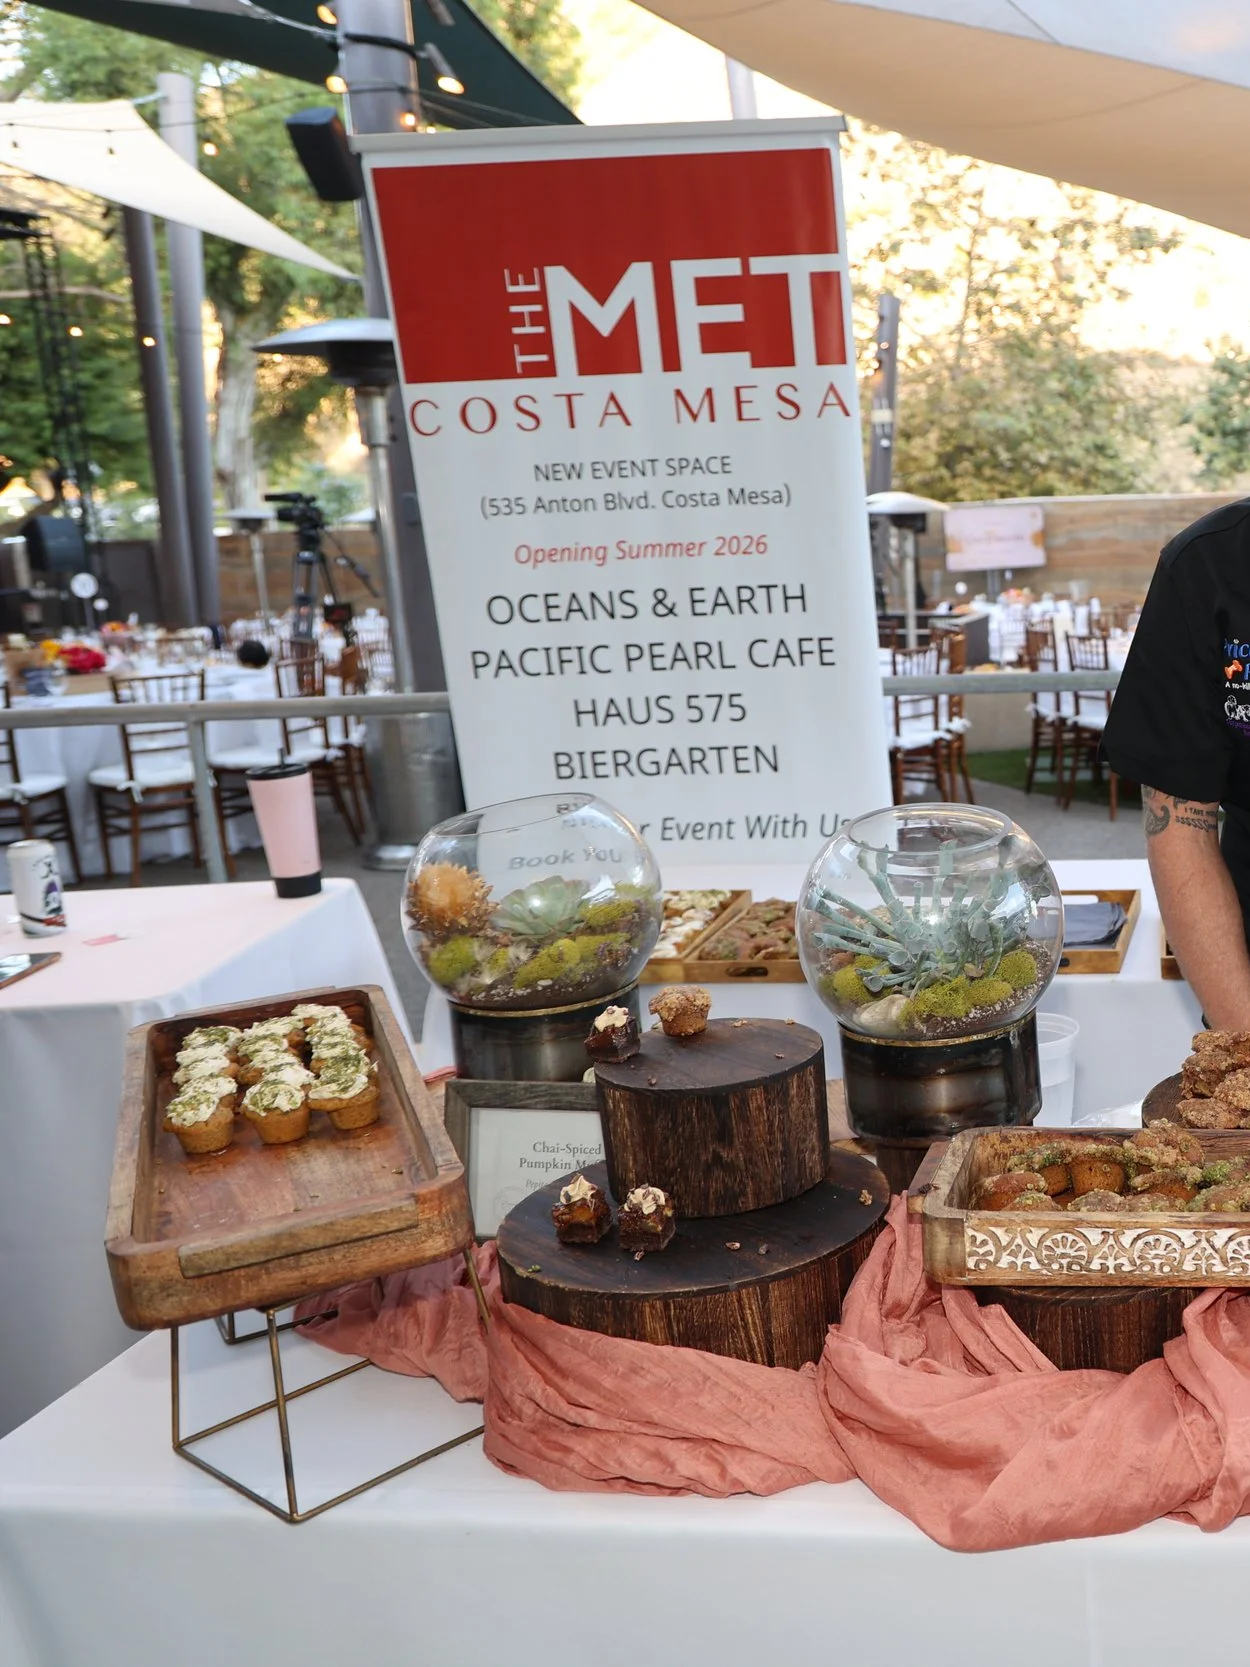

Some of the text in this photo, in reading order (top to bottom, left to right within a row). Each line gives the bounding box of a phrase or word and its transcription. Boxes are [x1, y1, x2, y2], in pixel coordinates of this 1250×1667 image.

[503, 267, 550, 374] THE
[543, 254, 841, 377] MET
[409, 382, 852, 436] COSTA MESA
[534, 456, 733, 482] NEW EVENT SPACE
[480, 483, 792, 519] (535 Anton Blvd. Costa Mesa)
[513, 534, 768, 570] Opening Summer 2026
[486, 583, 808, 625] OCEANS & EARTH
[470, 637, 836, 680] PACIFIC PEARL CAFE
[573, 693, 747, 727] HAUS 575
[553, 745, 779, 780] BIERGARTEN
[659, 816, 736, 841] Event
[744, 814, 809, 839] With
[519, 1158, 571, 1172] Pumpkin
[533, 1141, 602, 1158] Chai-Spiced
